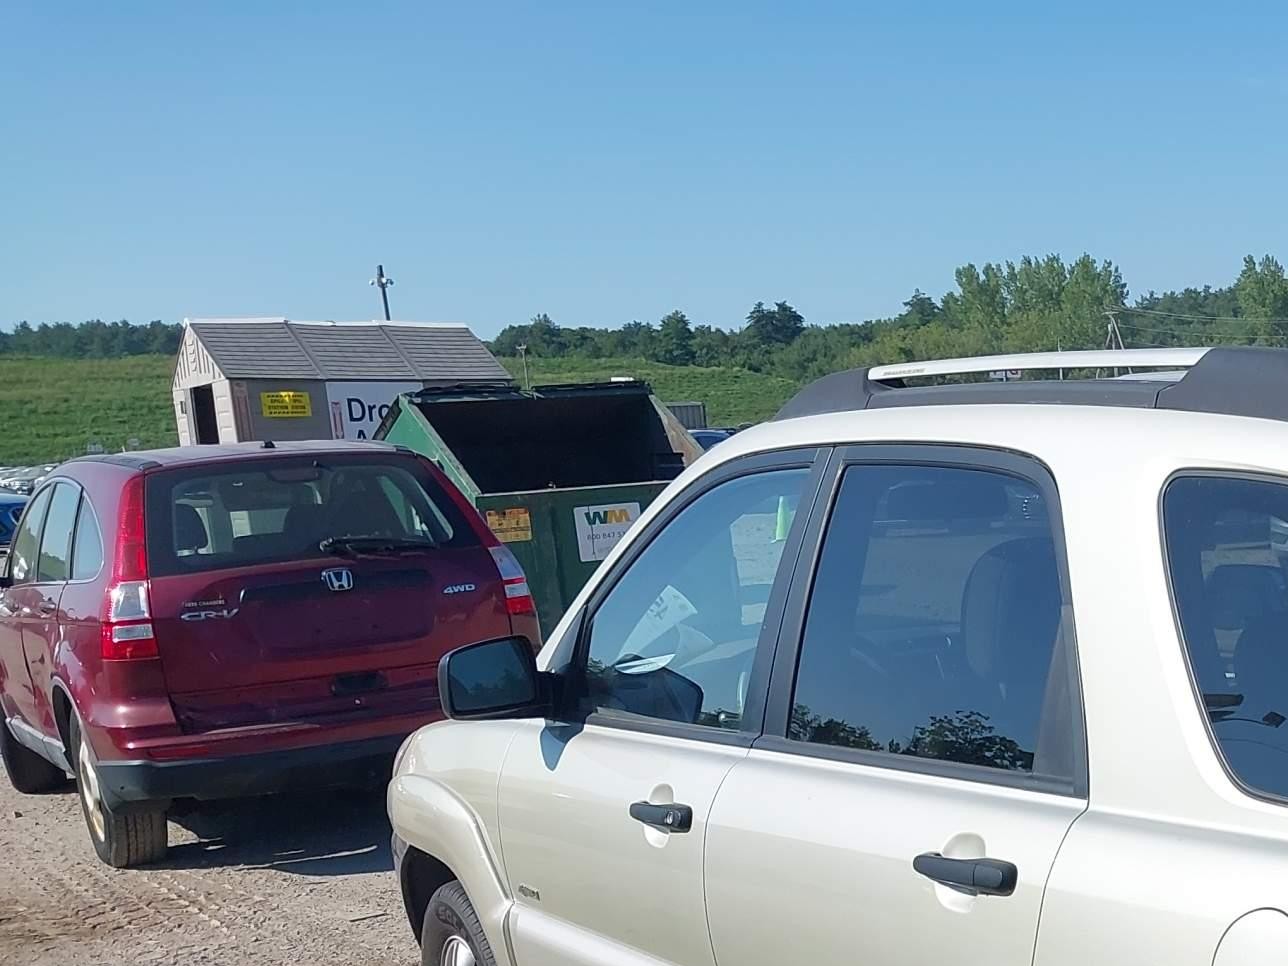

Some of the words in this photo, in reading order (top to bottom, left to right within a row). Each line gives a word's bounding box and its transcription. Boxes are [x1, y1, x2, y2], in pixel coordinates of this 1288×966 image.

[585, 509, 630, 525] WM
[443, 583, 476, 594] 4WD
[181, 608, 239, 621] CR-V
